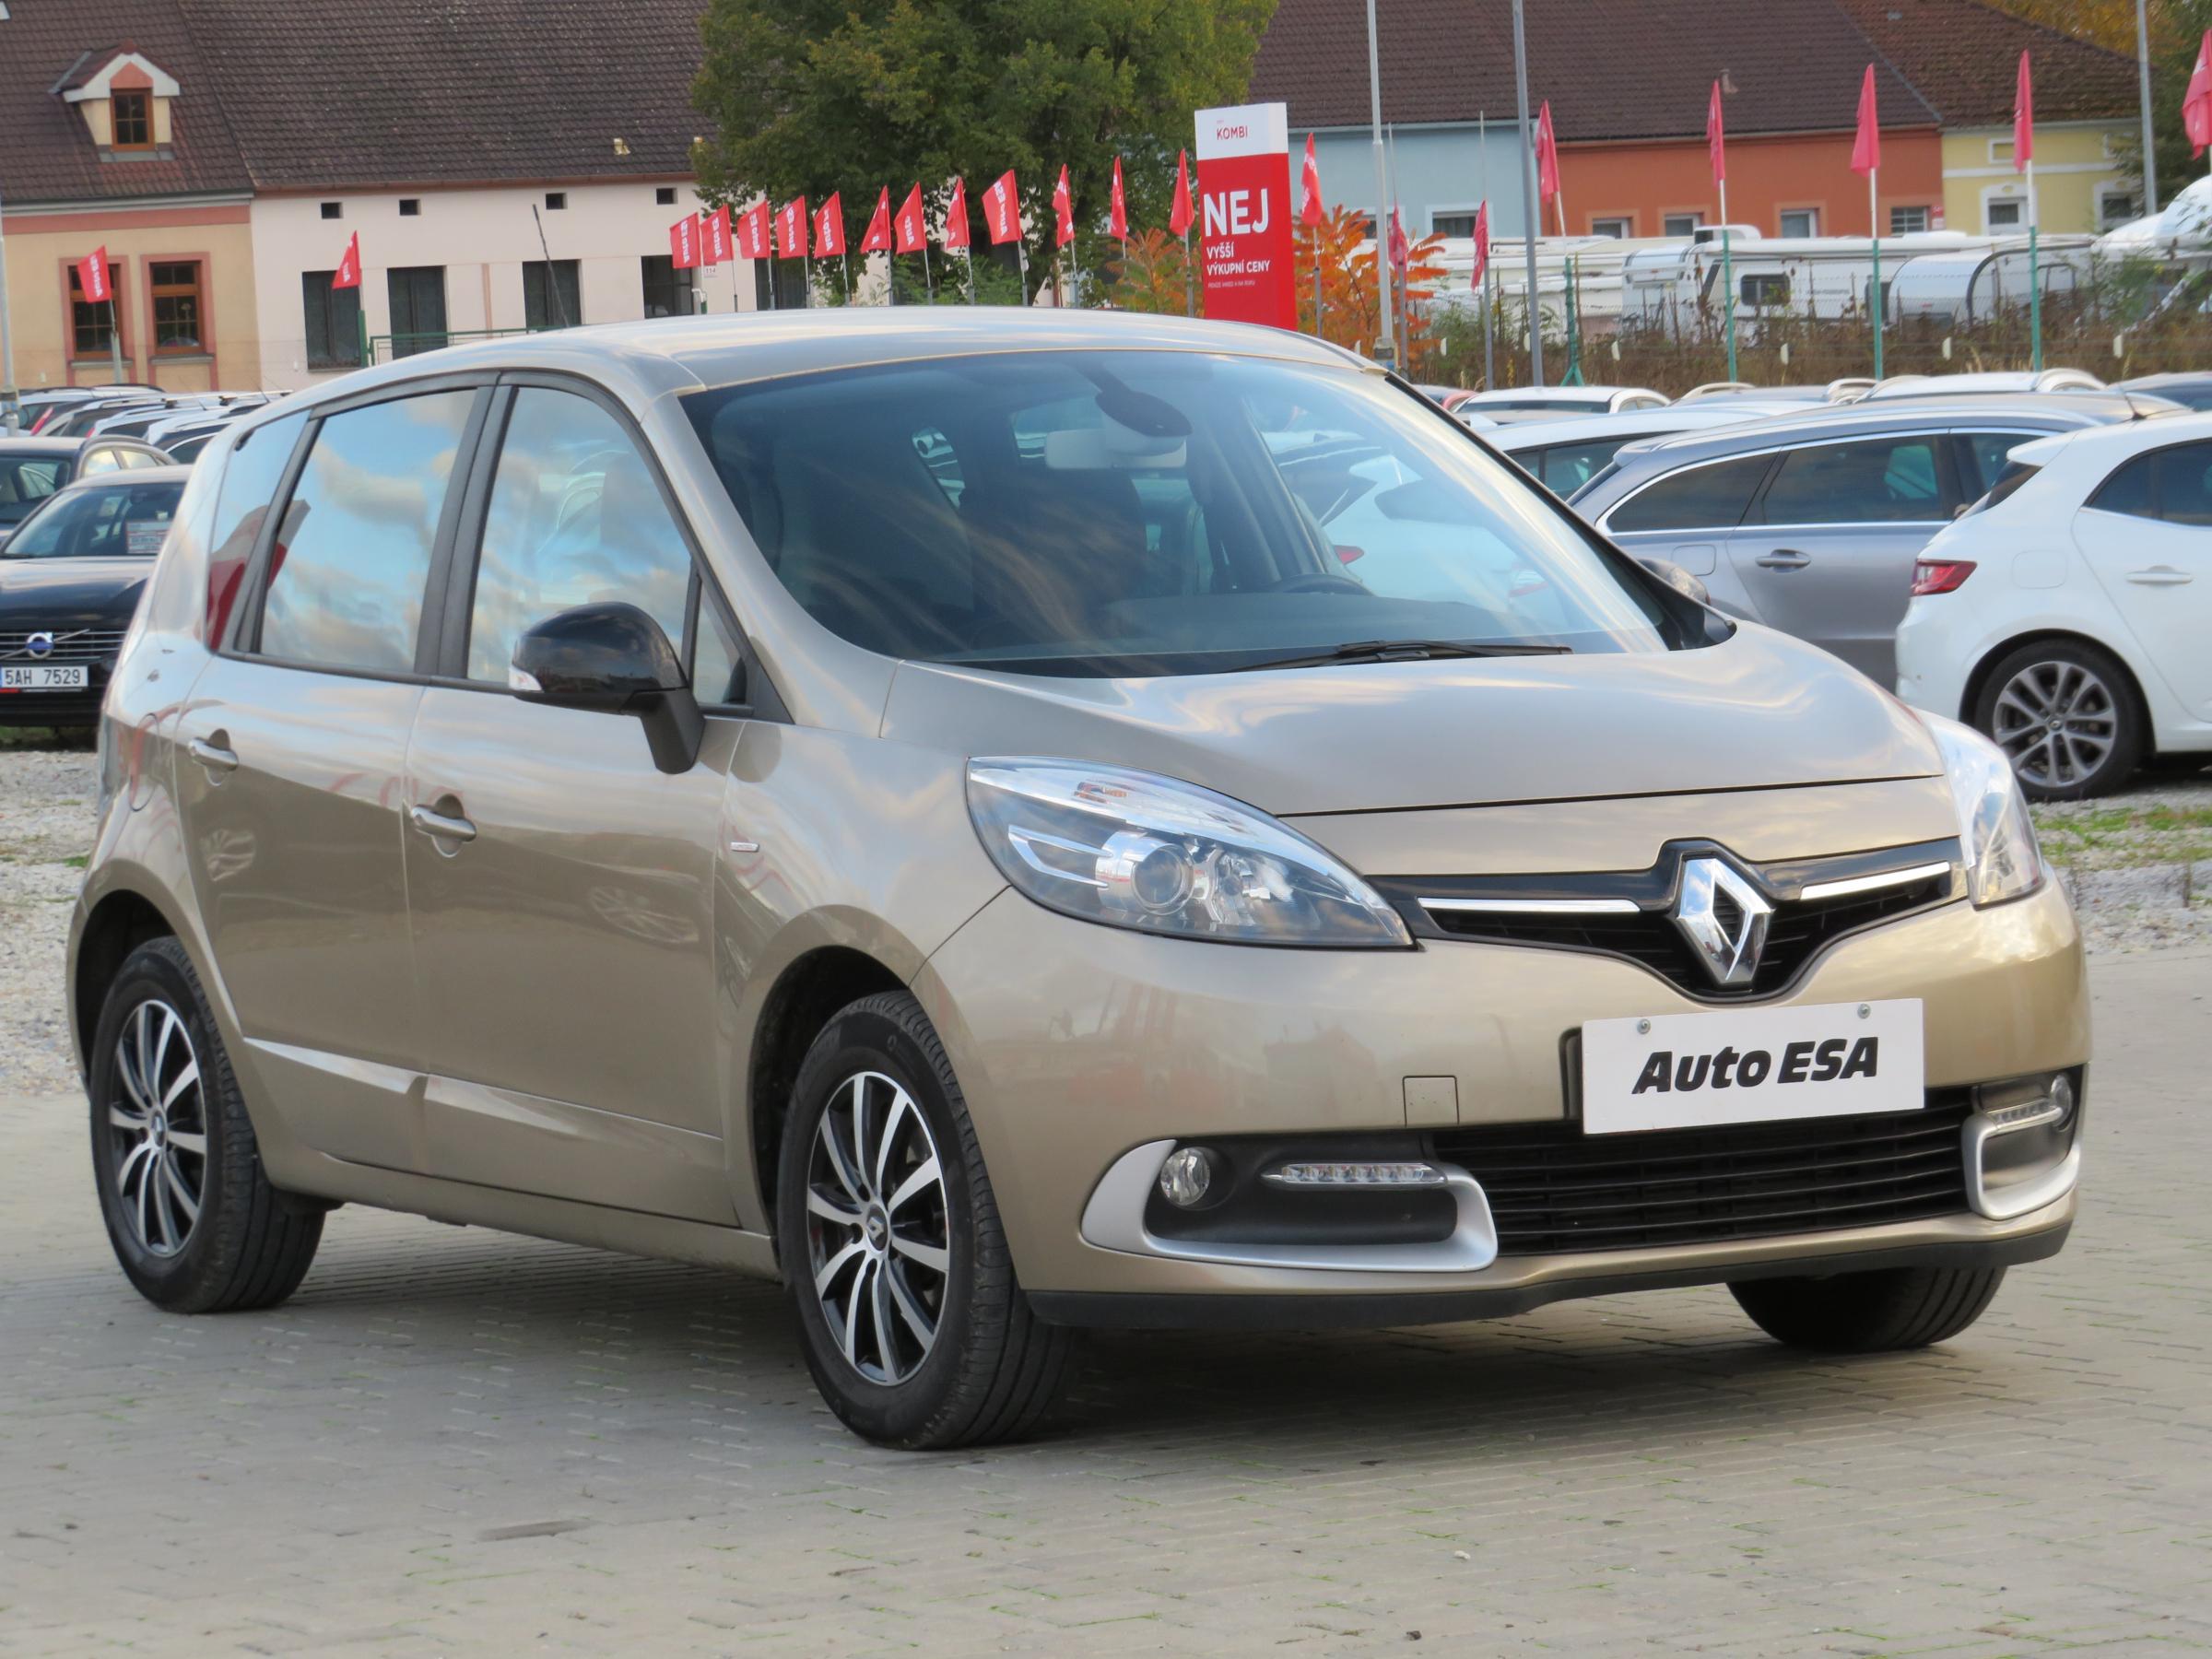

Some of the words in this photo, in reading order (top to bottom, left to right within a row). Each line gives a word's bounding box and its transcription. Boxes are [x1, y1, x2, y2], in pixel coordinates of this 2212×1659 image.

[1217, 125, 1248, 140] KOMBI
[1204, 188, 1268, 237] NEJ
[1206, 241, 1234, 260] VYŠŠÍ
[1206, 259, 1244, 276] VÝKUPNÍ
[1246, 260, 1270, 273] CENY
[5, 669, 32, 685] 5AH
[43, 669, 81, 685] 7529
[1631, 1046, 1771, 1094] Auto
[1777, 1036, 1878, 1084] ESA
